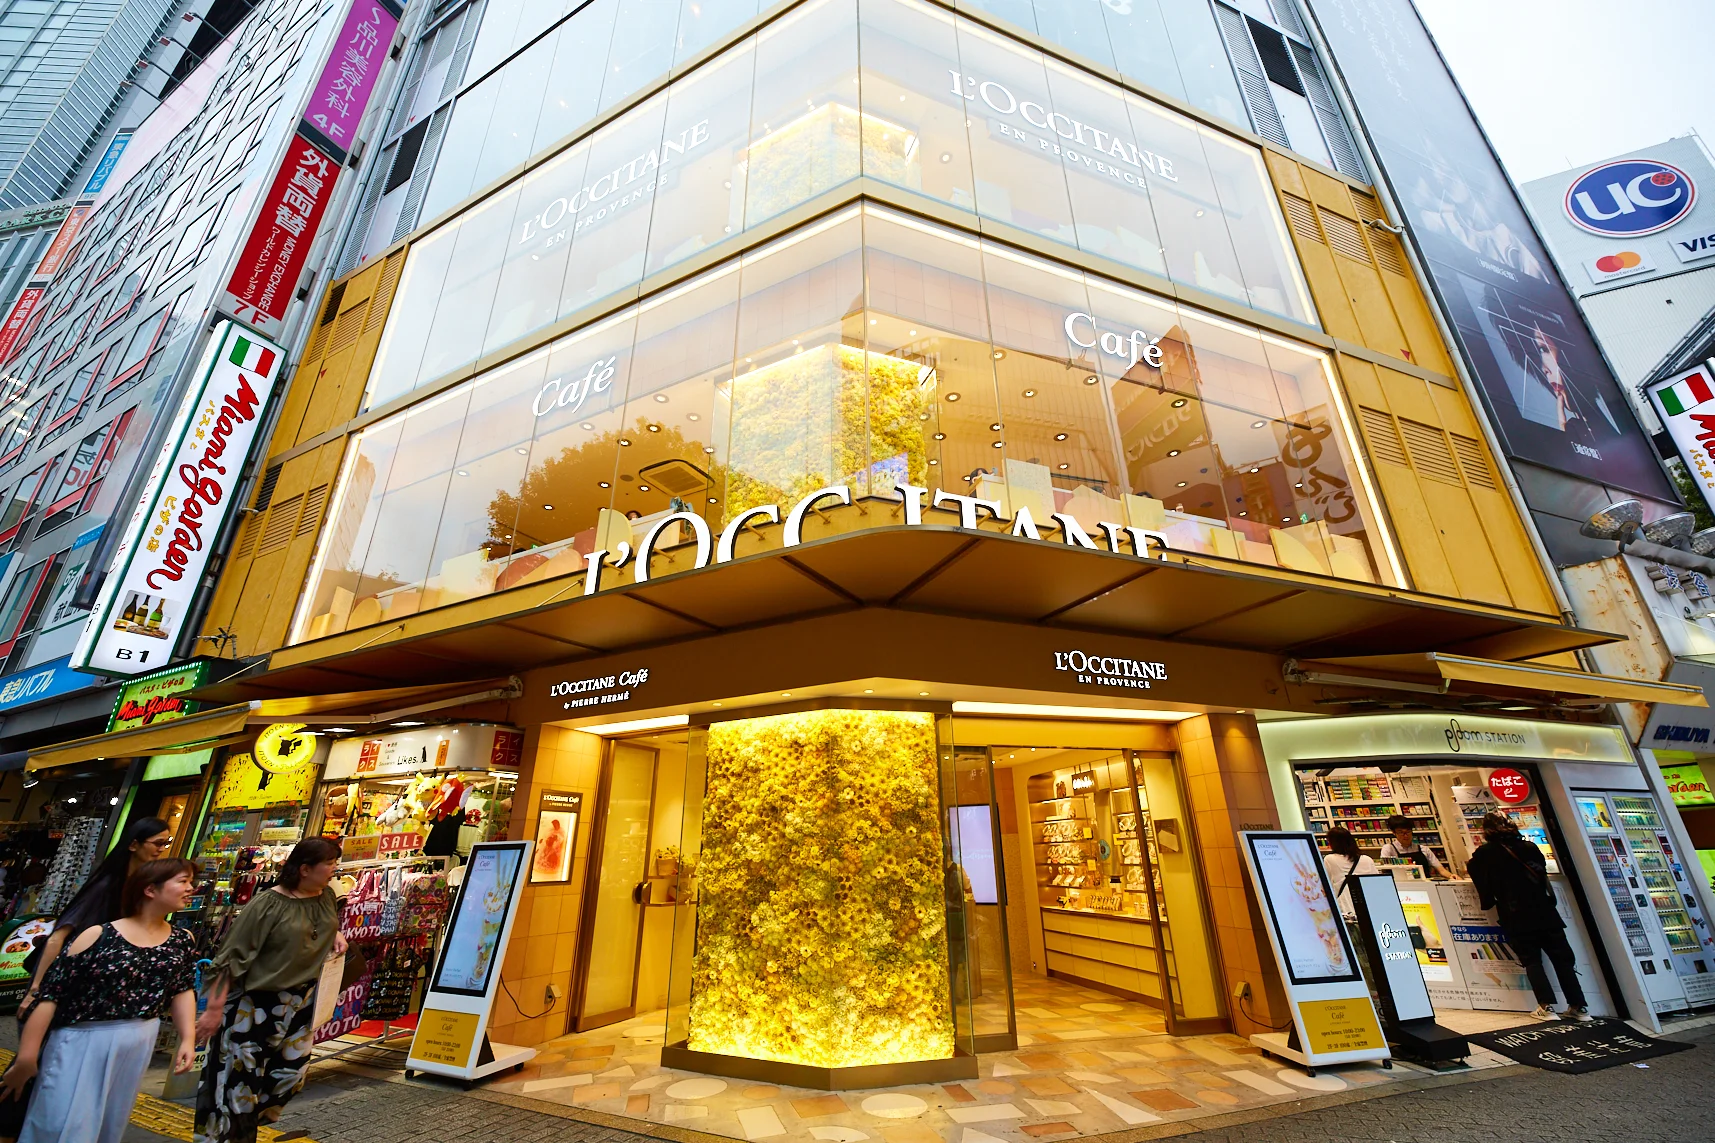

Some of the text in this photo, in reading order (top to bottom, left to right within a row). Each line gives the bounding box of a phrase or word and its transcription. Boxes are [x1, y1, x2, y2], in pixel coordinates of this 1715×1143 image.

[325, 21, 379, 119] 品川美容外科
[313, 113, 345, 137] 4F
[948, 69, 1179, 183] L'OCCITANE
[1000, 123, 1147, 189] EN PROVENCE
[275, 149, 329, 238] 外貨両替
[519, 119, 710, 245] L'OCCITANE
[1575, 171, 1682, 220] UC
[546, 173, 668, 248] EN PROVENCE
[258, 236, 297, 311] MONEY EXCHANGE
[1604, 265, 1646, 280] mastercard
[233, 299, 270, 325] 7F
[1064, 312, 1164, 370] Café
[532, 355, 616, 417] Café
[199, 373, 259, 476] Miami
[1054, 650, 1168, 680] L'OCCITANE
[550, 668, 648, 697] L'OCCITANE Café
[1078, 675, 1151, 689] EN PROVENCE
[571, 696, 599, 708] PIERRE
[1485, 731, 1526, 744] STATION
[1491, 776, 1524, 787] たばこ
[380, 835, 420, 850] SALE
[1263, 849, 1277, 857] Café
[1331, 1012, 1345, 1020] Café
